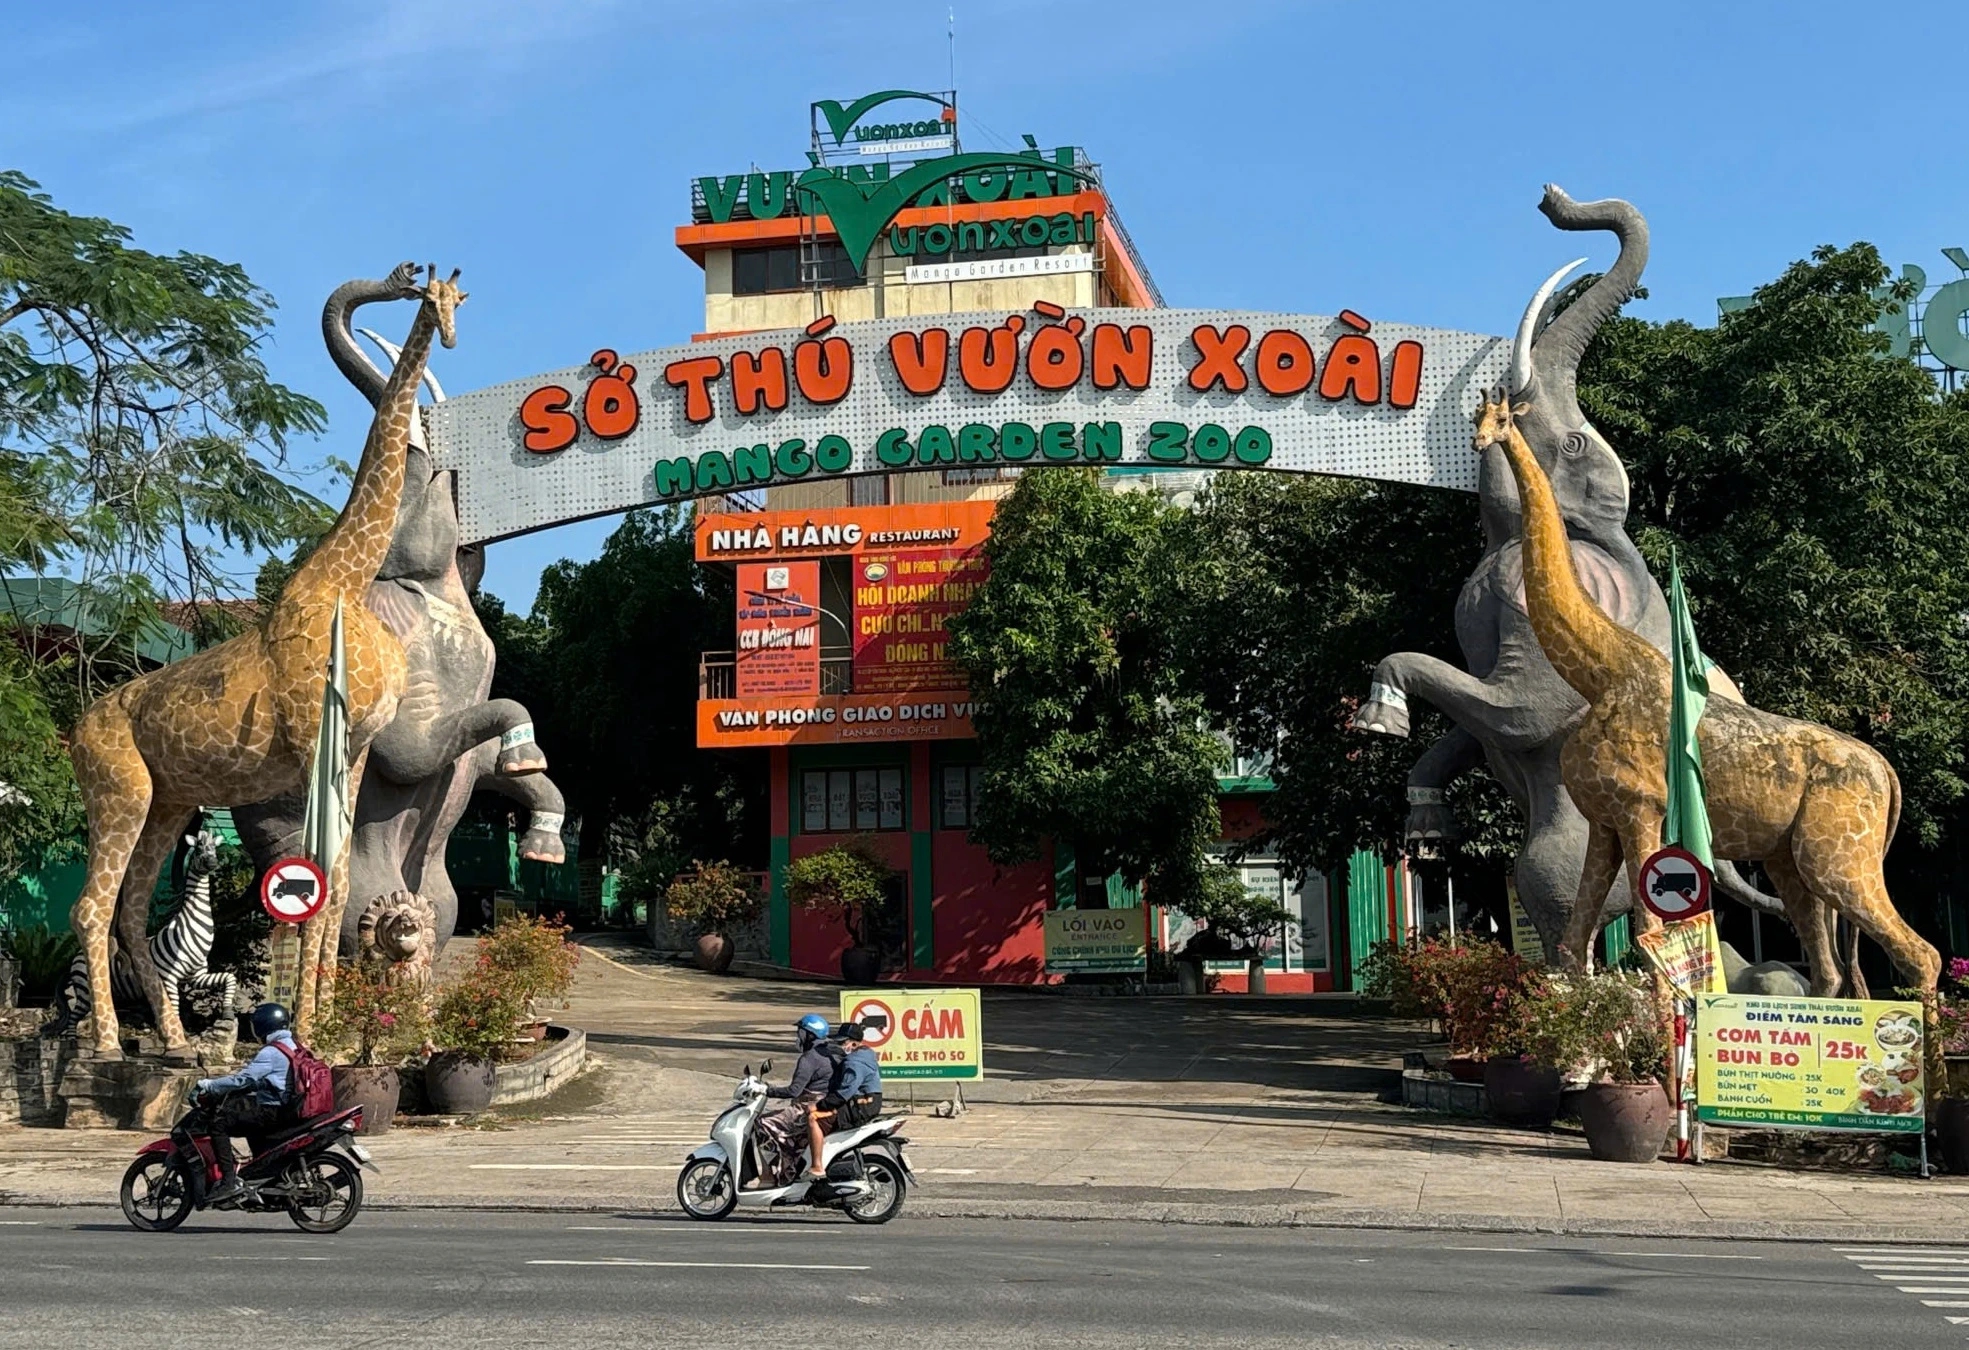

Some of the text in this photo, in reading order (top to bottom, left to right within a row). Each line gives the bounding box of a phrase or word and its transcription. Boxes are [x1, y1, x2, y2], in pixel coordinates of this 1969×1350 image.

[910, 255, 1089, 281] Mango Garden Resort
[520, 300, 1424, 454] SỞ THÚ VƯỜN XOÀI
[654, 420, 1273, 497] MANGO GARDEN ZOO
[712, 519, 960, 550] NHÀ HÀNG RESTAURANT
[857, 583, 883, 609] HỘI
[886, 583, 940, 606] DOANH
[761, 618, 793, 649] ĐỒNG
[794, 627, 815, 647] NAI
[719, 707, 759, 727] VĂN
[765, 705, 836, 726] PHÒNG
[842, 705, 893, 723] GIAO
[899, 702, 946, 725] DỊCH
[1062, 913, 1126, 932] LỐI VÀO
[1071, 932, 1118, 941] ENTRANCE
[901, 998, 965, 1040] CẤM
[1746, 1010, 1864, 1026] ĐIỂM TÂM SÁNG
[1716, 1026, 1812, 1046] CƠM TẤM
[905, 1051, 919, 1061] XE
[950, 1050, 965, 1061] SƠ
[1716, 1047, 1800, 1067] BÚN BÒ
[1825, 1040, 1868, 1060] 25K
[1739, 1071, 1759, 1080] THỊT
[1717, 1093, 1743, 1103] BÁNH
[1745, 1092, 1773, 1104] CUỐN
[1745, 1110, 1766, 1119] CHO
